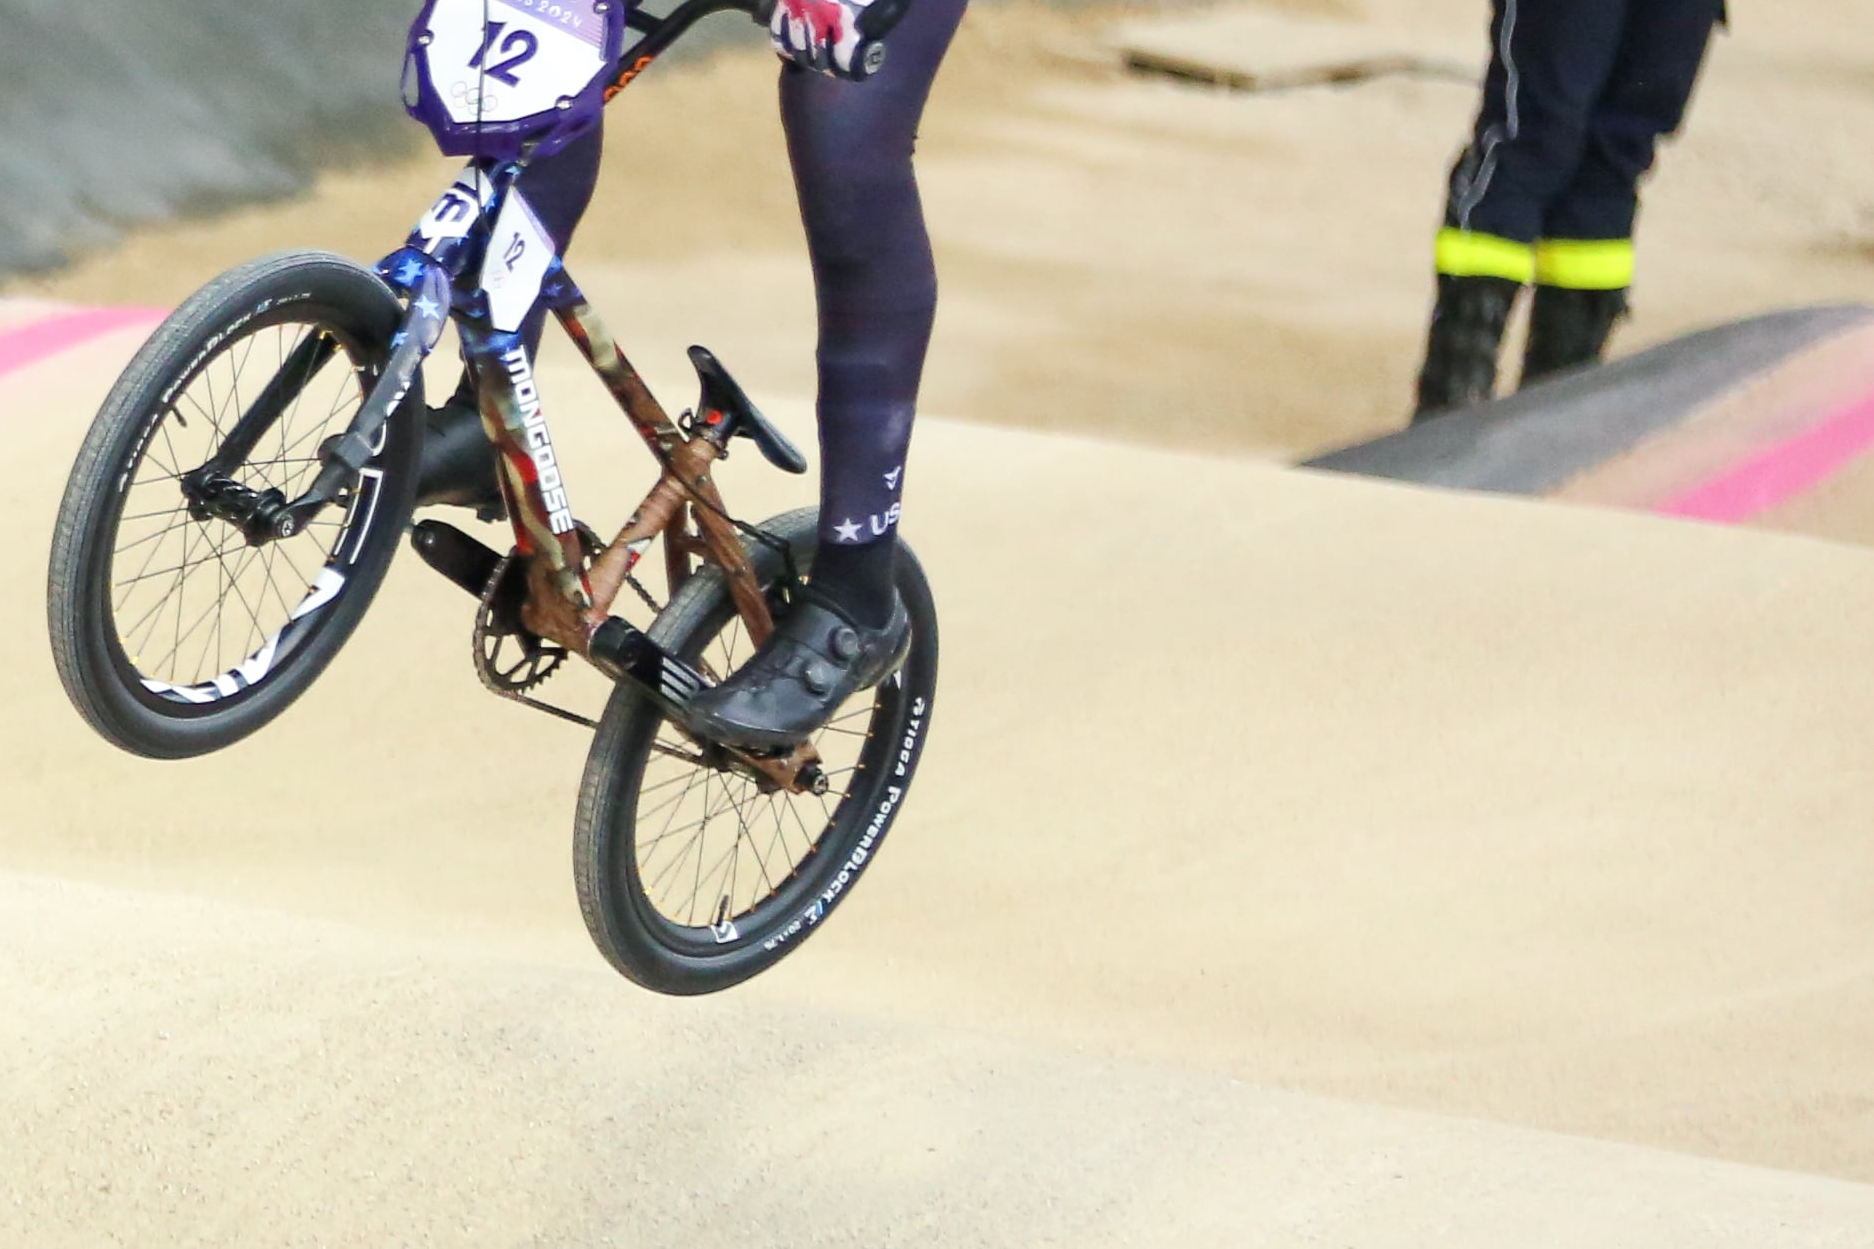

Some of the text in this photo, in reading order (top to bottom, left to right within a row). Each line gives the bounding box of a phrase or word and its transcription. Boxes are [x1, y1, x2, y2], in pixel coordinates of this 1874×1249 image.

[537, 0, 583, 29] 2024
[467, 21, 538, 88] 12
[503, 232, 526, 272] 12
[505, 343, 574, 536] MONGOOSE
